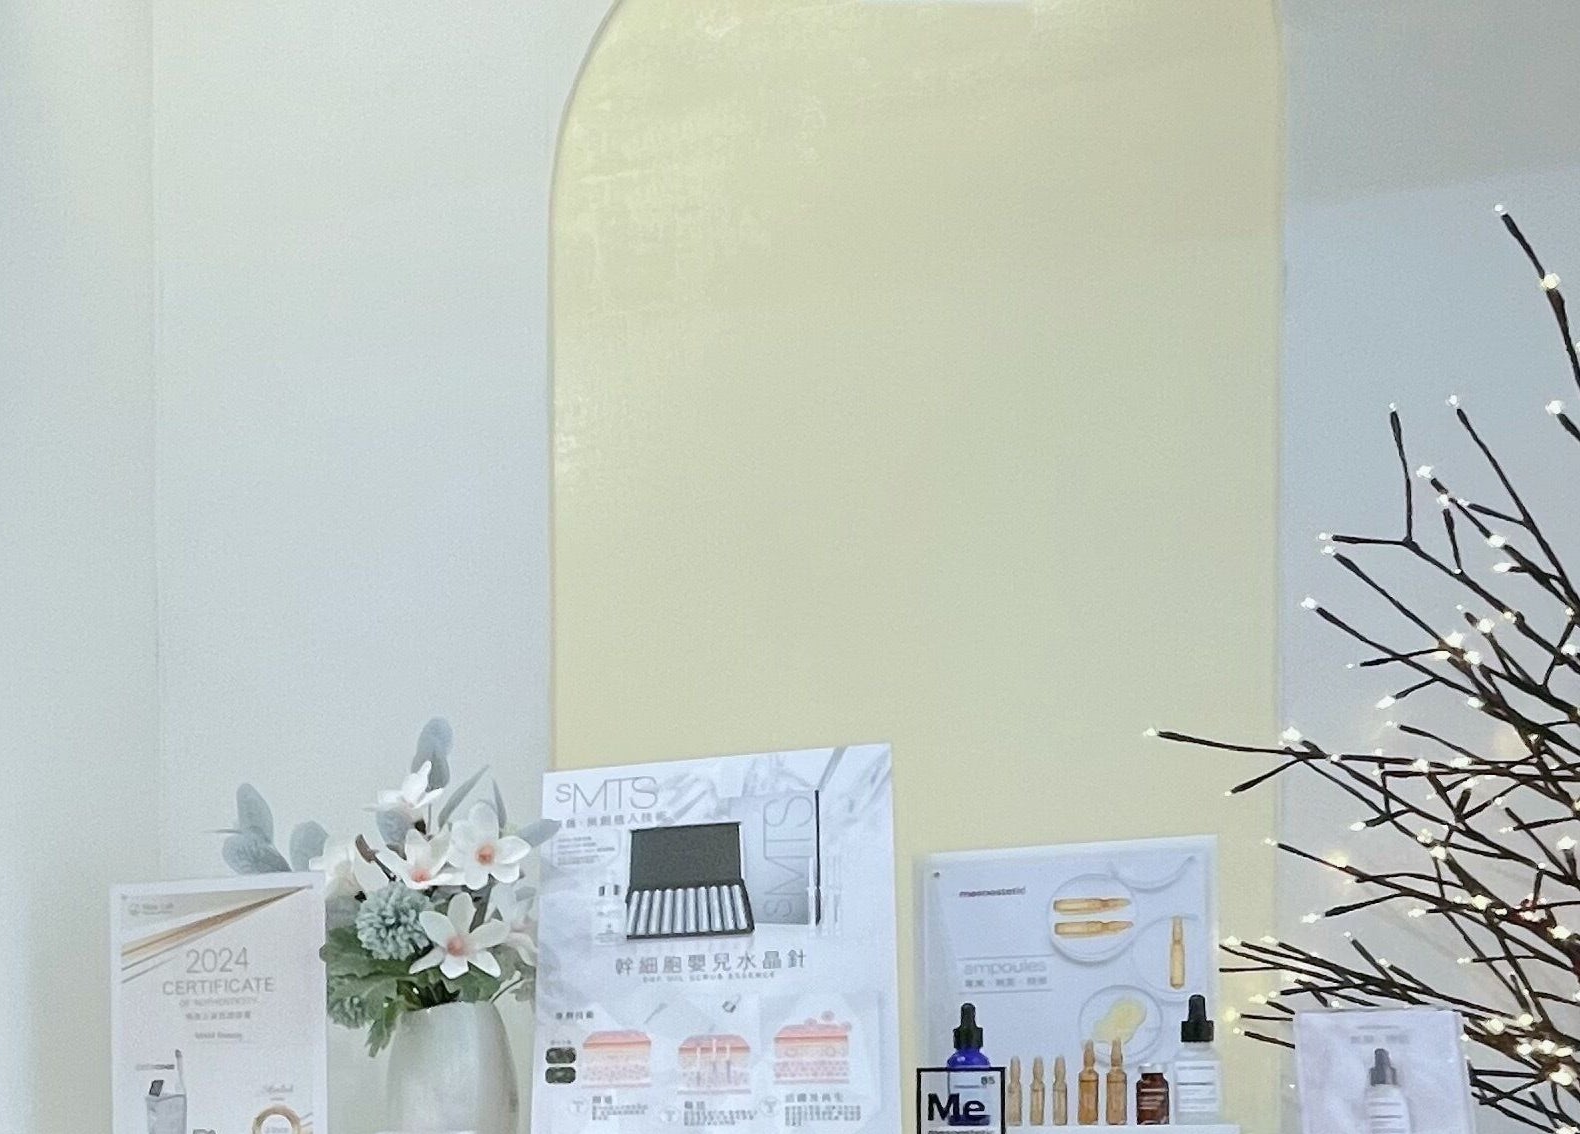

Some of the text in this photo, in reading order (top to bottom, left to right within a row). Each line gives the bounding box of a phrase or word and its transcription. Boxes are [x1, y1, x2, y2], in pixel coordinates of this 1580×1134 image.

[555, 775, 659, 814] SMTS
[185, 947, 250, 974] 2024
[964, 960, 1047, 977] ampoules
[162, 977, 276, 996] CERTIFICATE
[927, 1092, 986, 1121] Me
